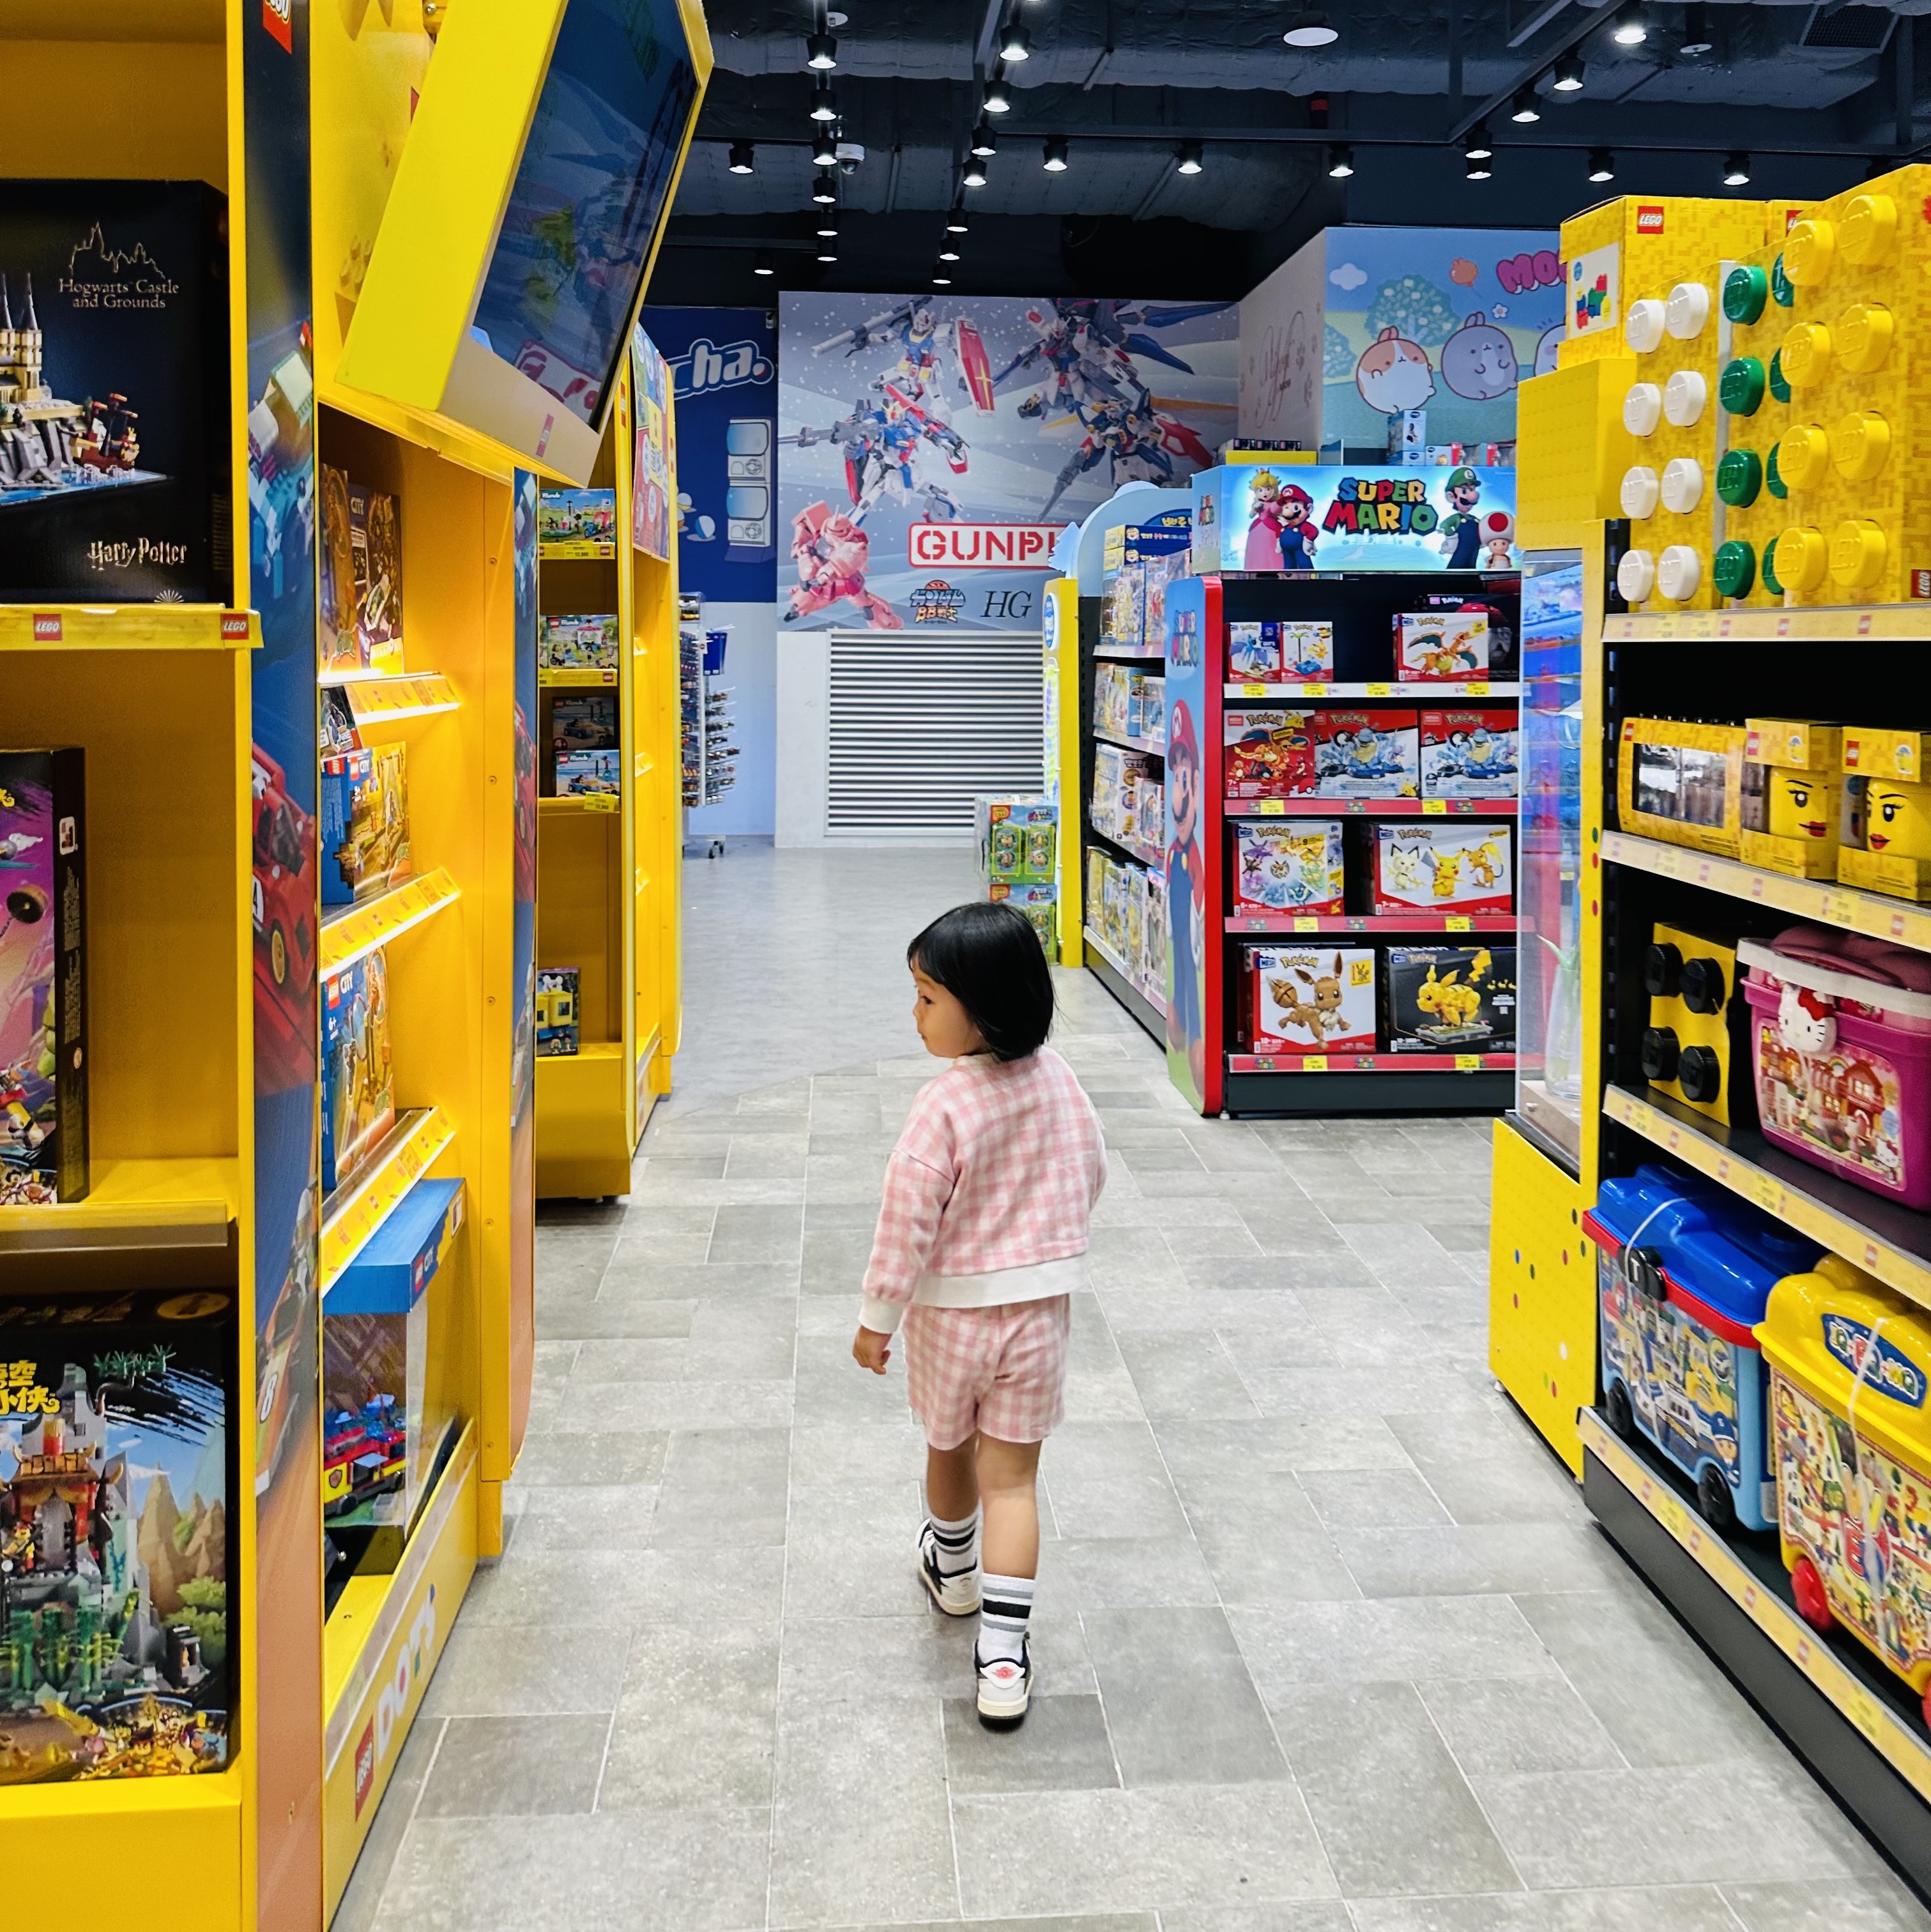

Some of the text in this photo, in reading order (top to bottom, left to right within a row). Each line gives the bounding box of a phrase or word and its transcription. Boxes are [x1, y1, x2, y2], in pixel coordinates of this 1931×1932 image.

[1639, 213, 1663, 226] LEGO
[1496, 250, 1567, 295] MO
[59, 279, 179, 297] Hogwarts Castle
[73, 294, 165, 308] and Grounds
[1338, 477, 1426, 502] SUPER
[1322, 500, 1439, 535] MARIO
[87, 537, 187, 571] Harry Potter
[980, 590, 1032, 618] HG
[34, 620, 60, 633] LEGO
[223, 620, 247, 632] LEGO
[1279, 954, 1319, 969] Pokémon
[340, 970, 353, 994] CITY
